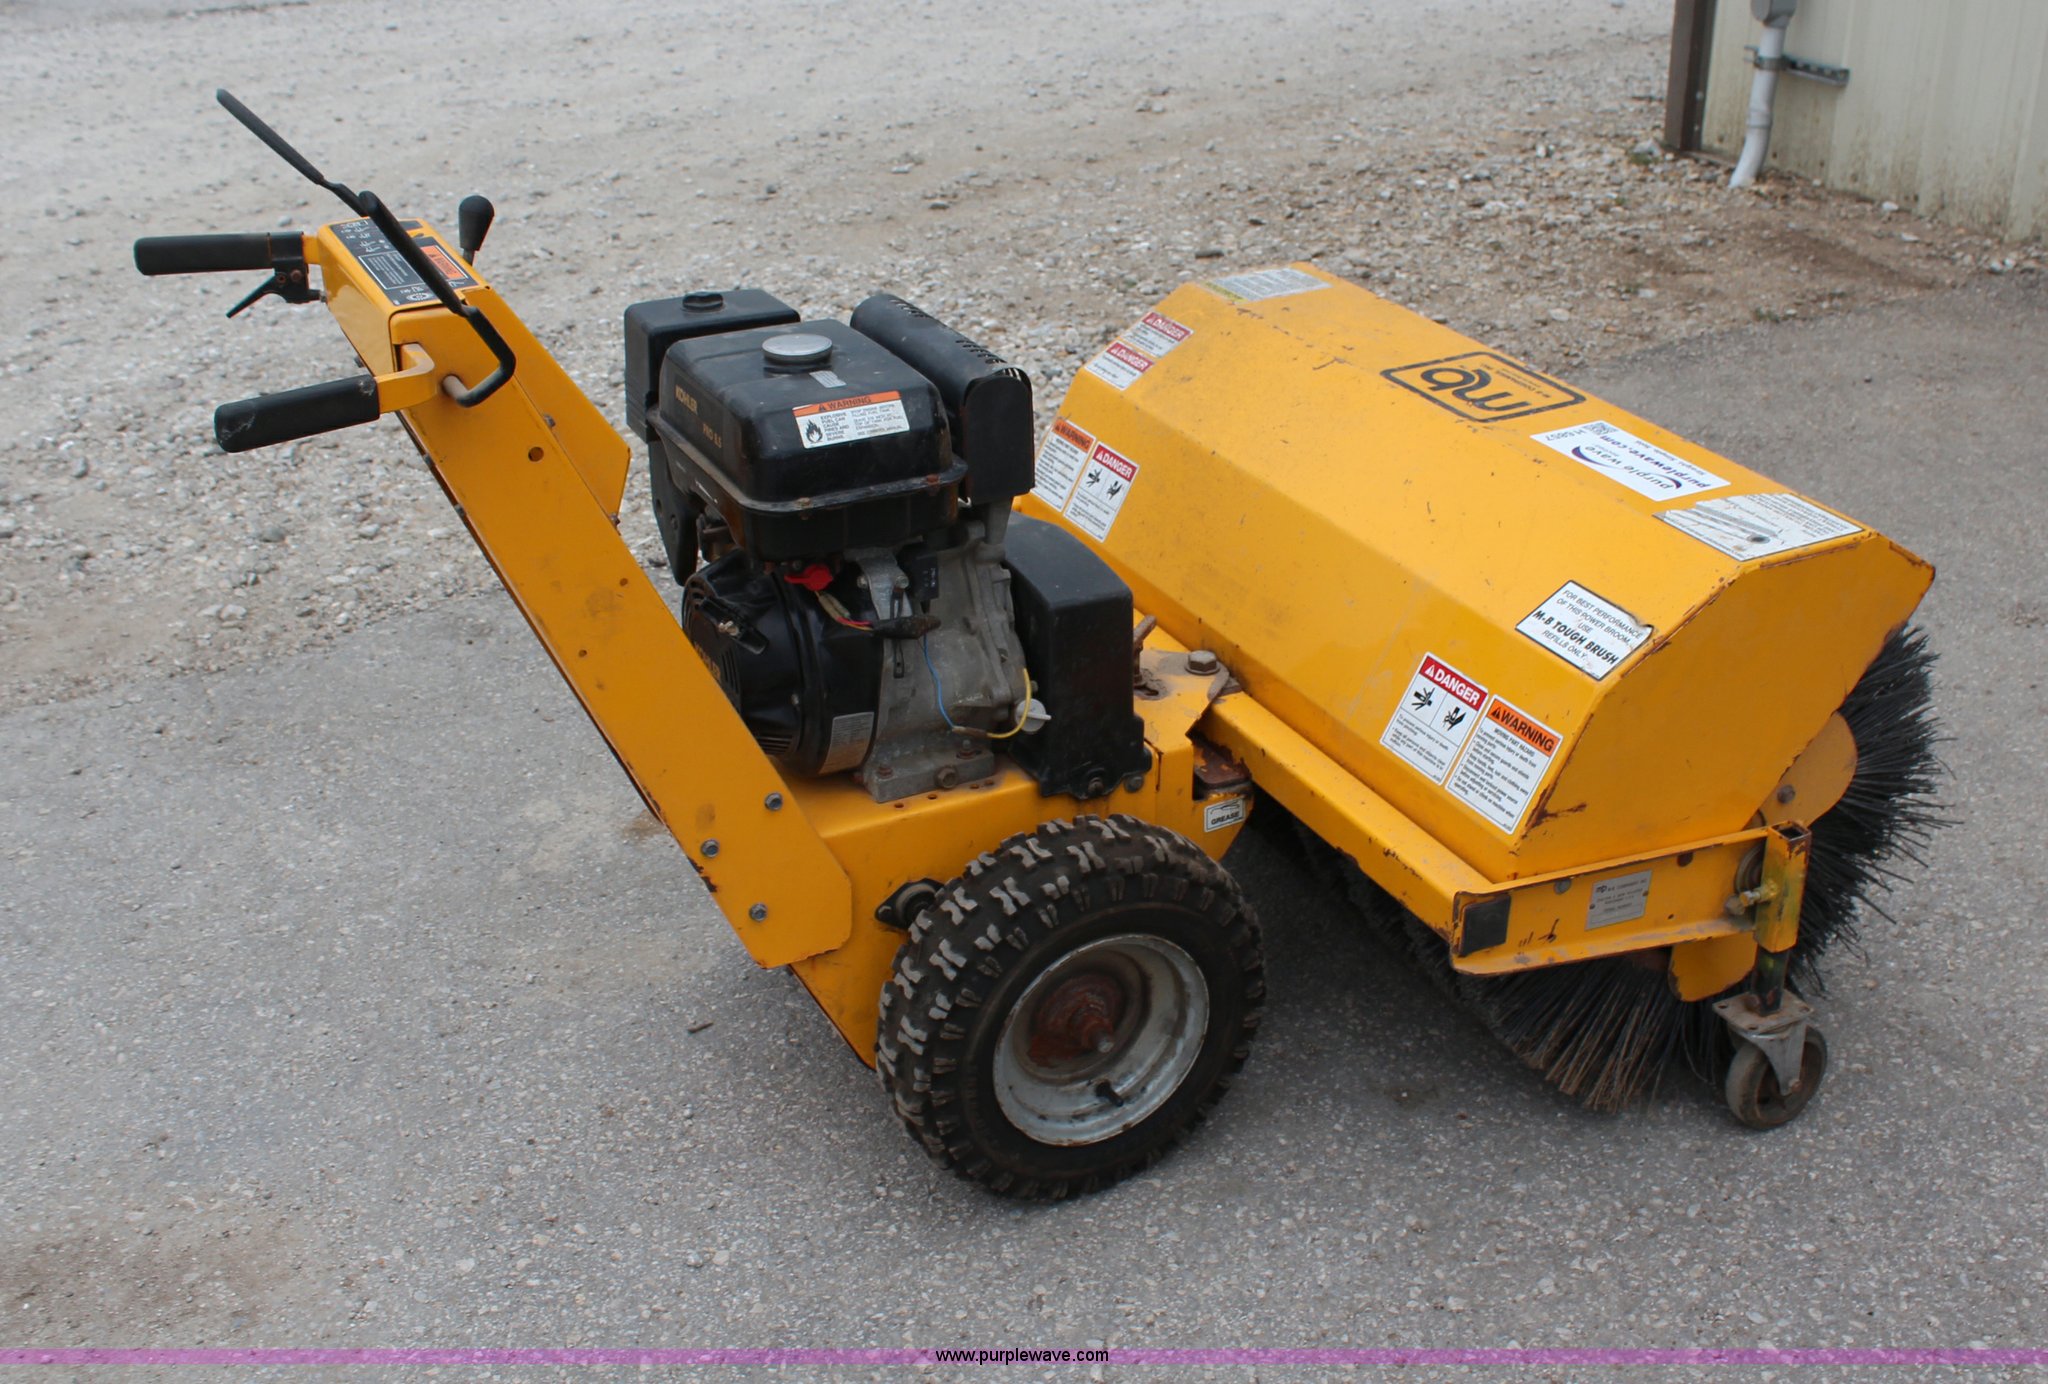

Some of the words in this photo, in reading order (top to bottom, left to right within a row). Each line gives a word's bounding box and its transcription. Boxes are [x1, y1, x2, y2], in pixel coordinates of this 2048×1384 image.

[1151, 317, 1187, 338] DANGER
[1115, 348, 1149, 370] DANGER
[827, 396, 871, 409] WARNING
[1059, 424, 1091, 450] WARNING
[1100, 451, 1133, 479] DANGER
[1585, 446, 1623, 465] wave
[1600, 435, 1711, 489] purplewave.com
[1624, 466, 1673, 489] purple
[1555, 597, 1568, 606] OF
[1565, 603, 1583, 615] THIS
[1578, 611, 1606, 629] POWER
[1561, 589, 1578, 600] FOR
[1574, 597, 1595, 610] BEST
[1590, 607, 1644, 639] PERFORMANCE
[1541, 629, 1570, 648] REFILLS
[1576, 622, 1593, 633] USE
[1550, 621, 1587, 645] TOUGH
[1583, 640, 1620, 665] BRUSH
[1432, 667, 1481, 706] DANGER
[1501, 709, 1556, 752] WARNING
[1211, 811, 1240, 825] GREASE
